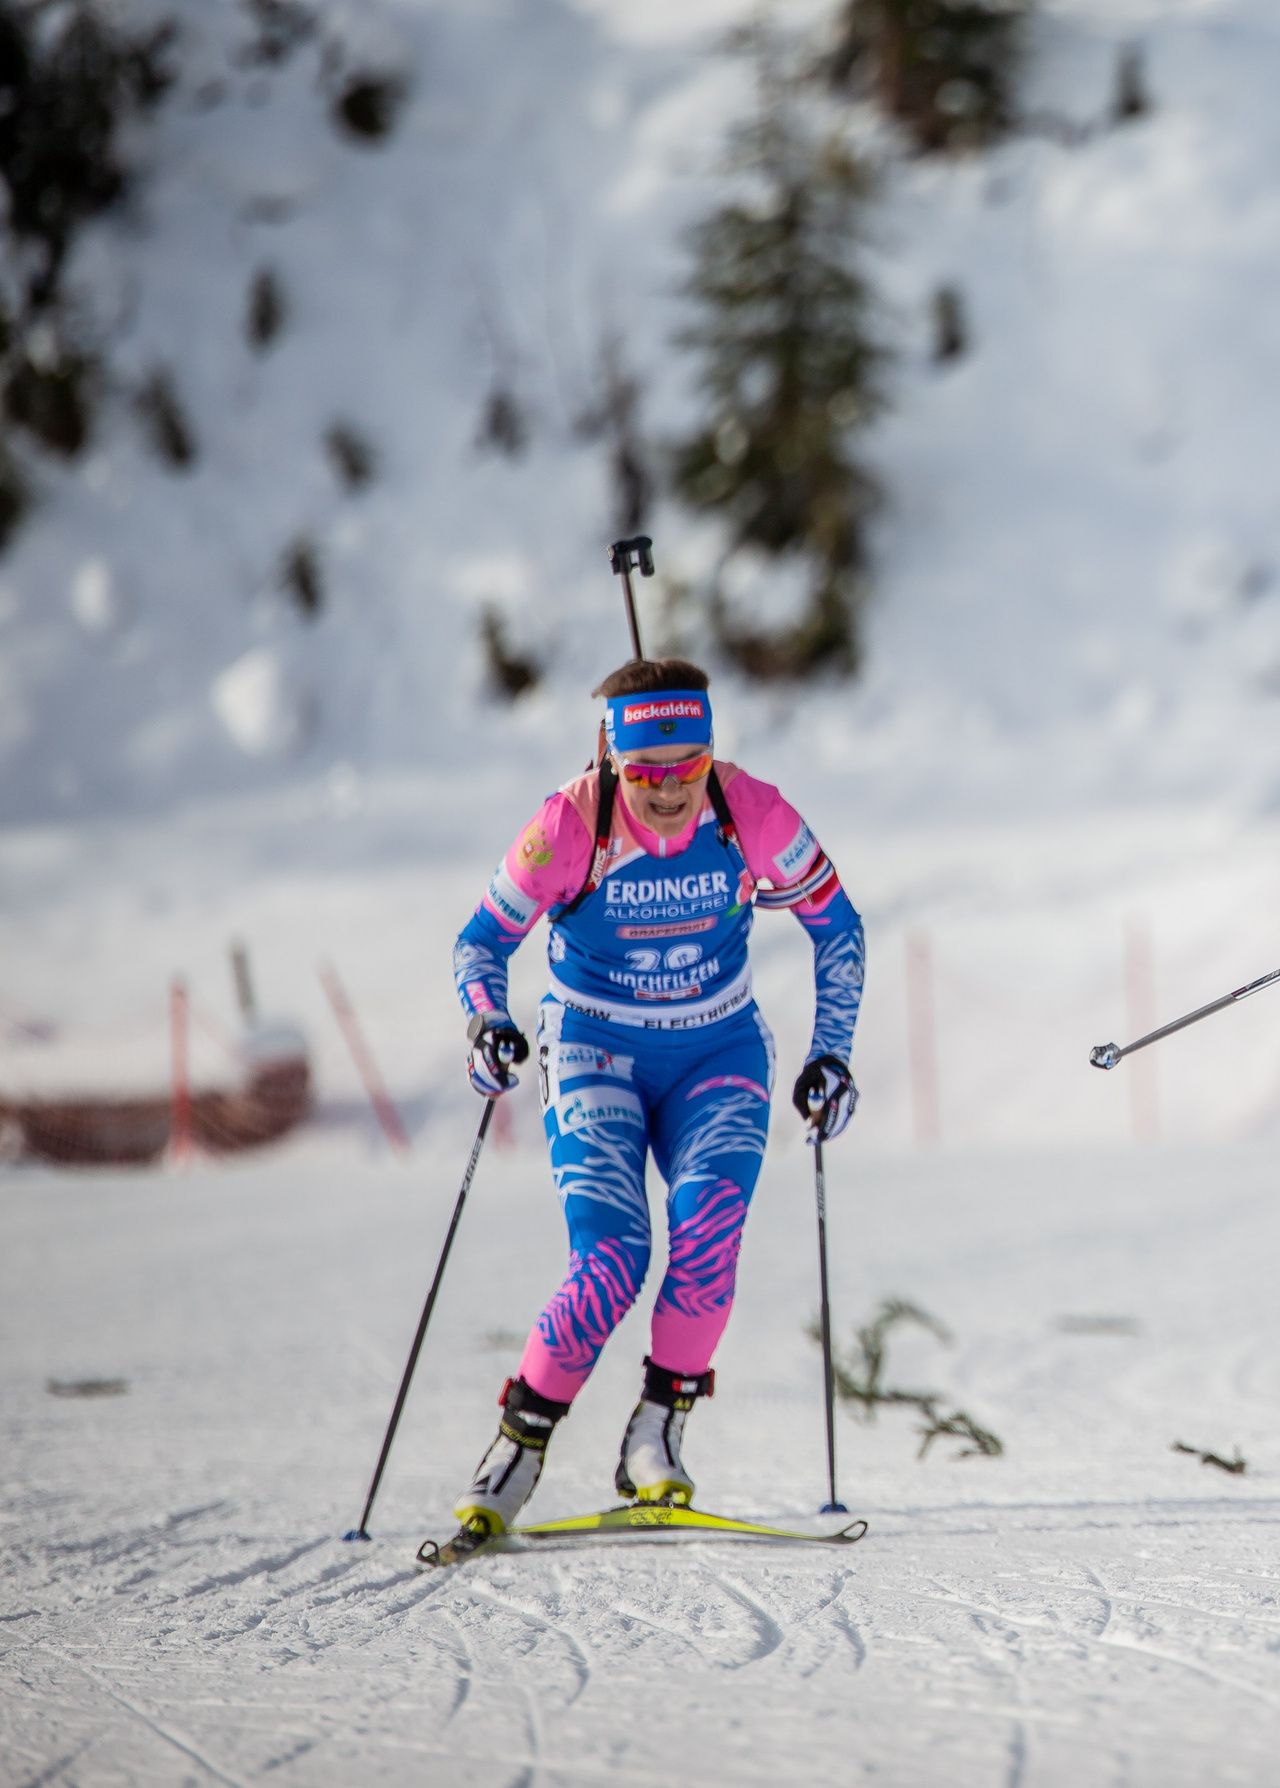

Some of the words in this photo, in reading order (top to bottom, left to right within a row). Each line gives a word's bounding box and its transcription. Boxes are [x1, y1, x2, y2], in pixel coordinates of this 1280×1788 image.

[624, 701, 701, 722] backaldrin
[605, 871, 730, 906] ERDINGER
[603, 894, 729, 919] ALKOHOLFREI
